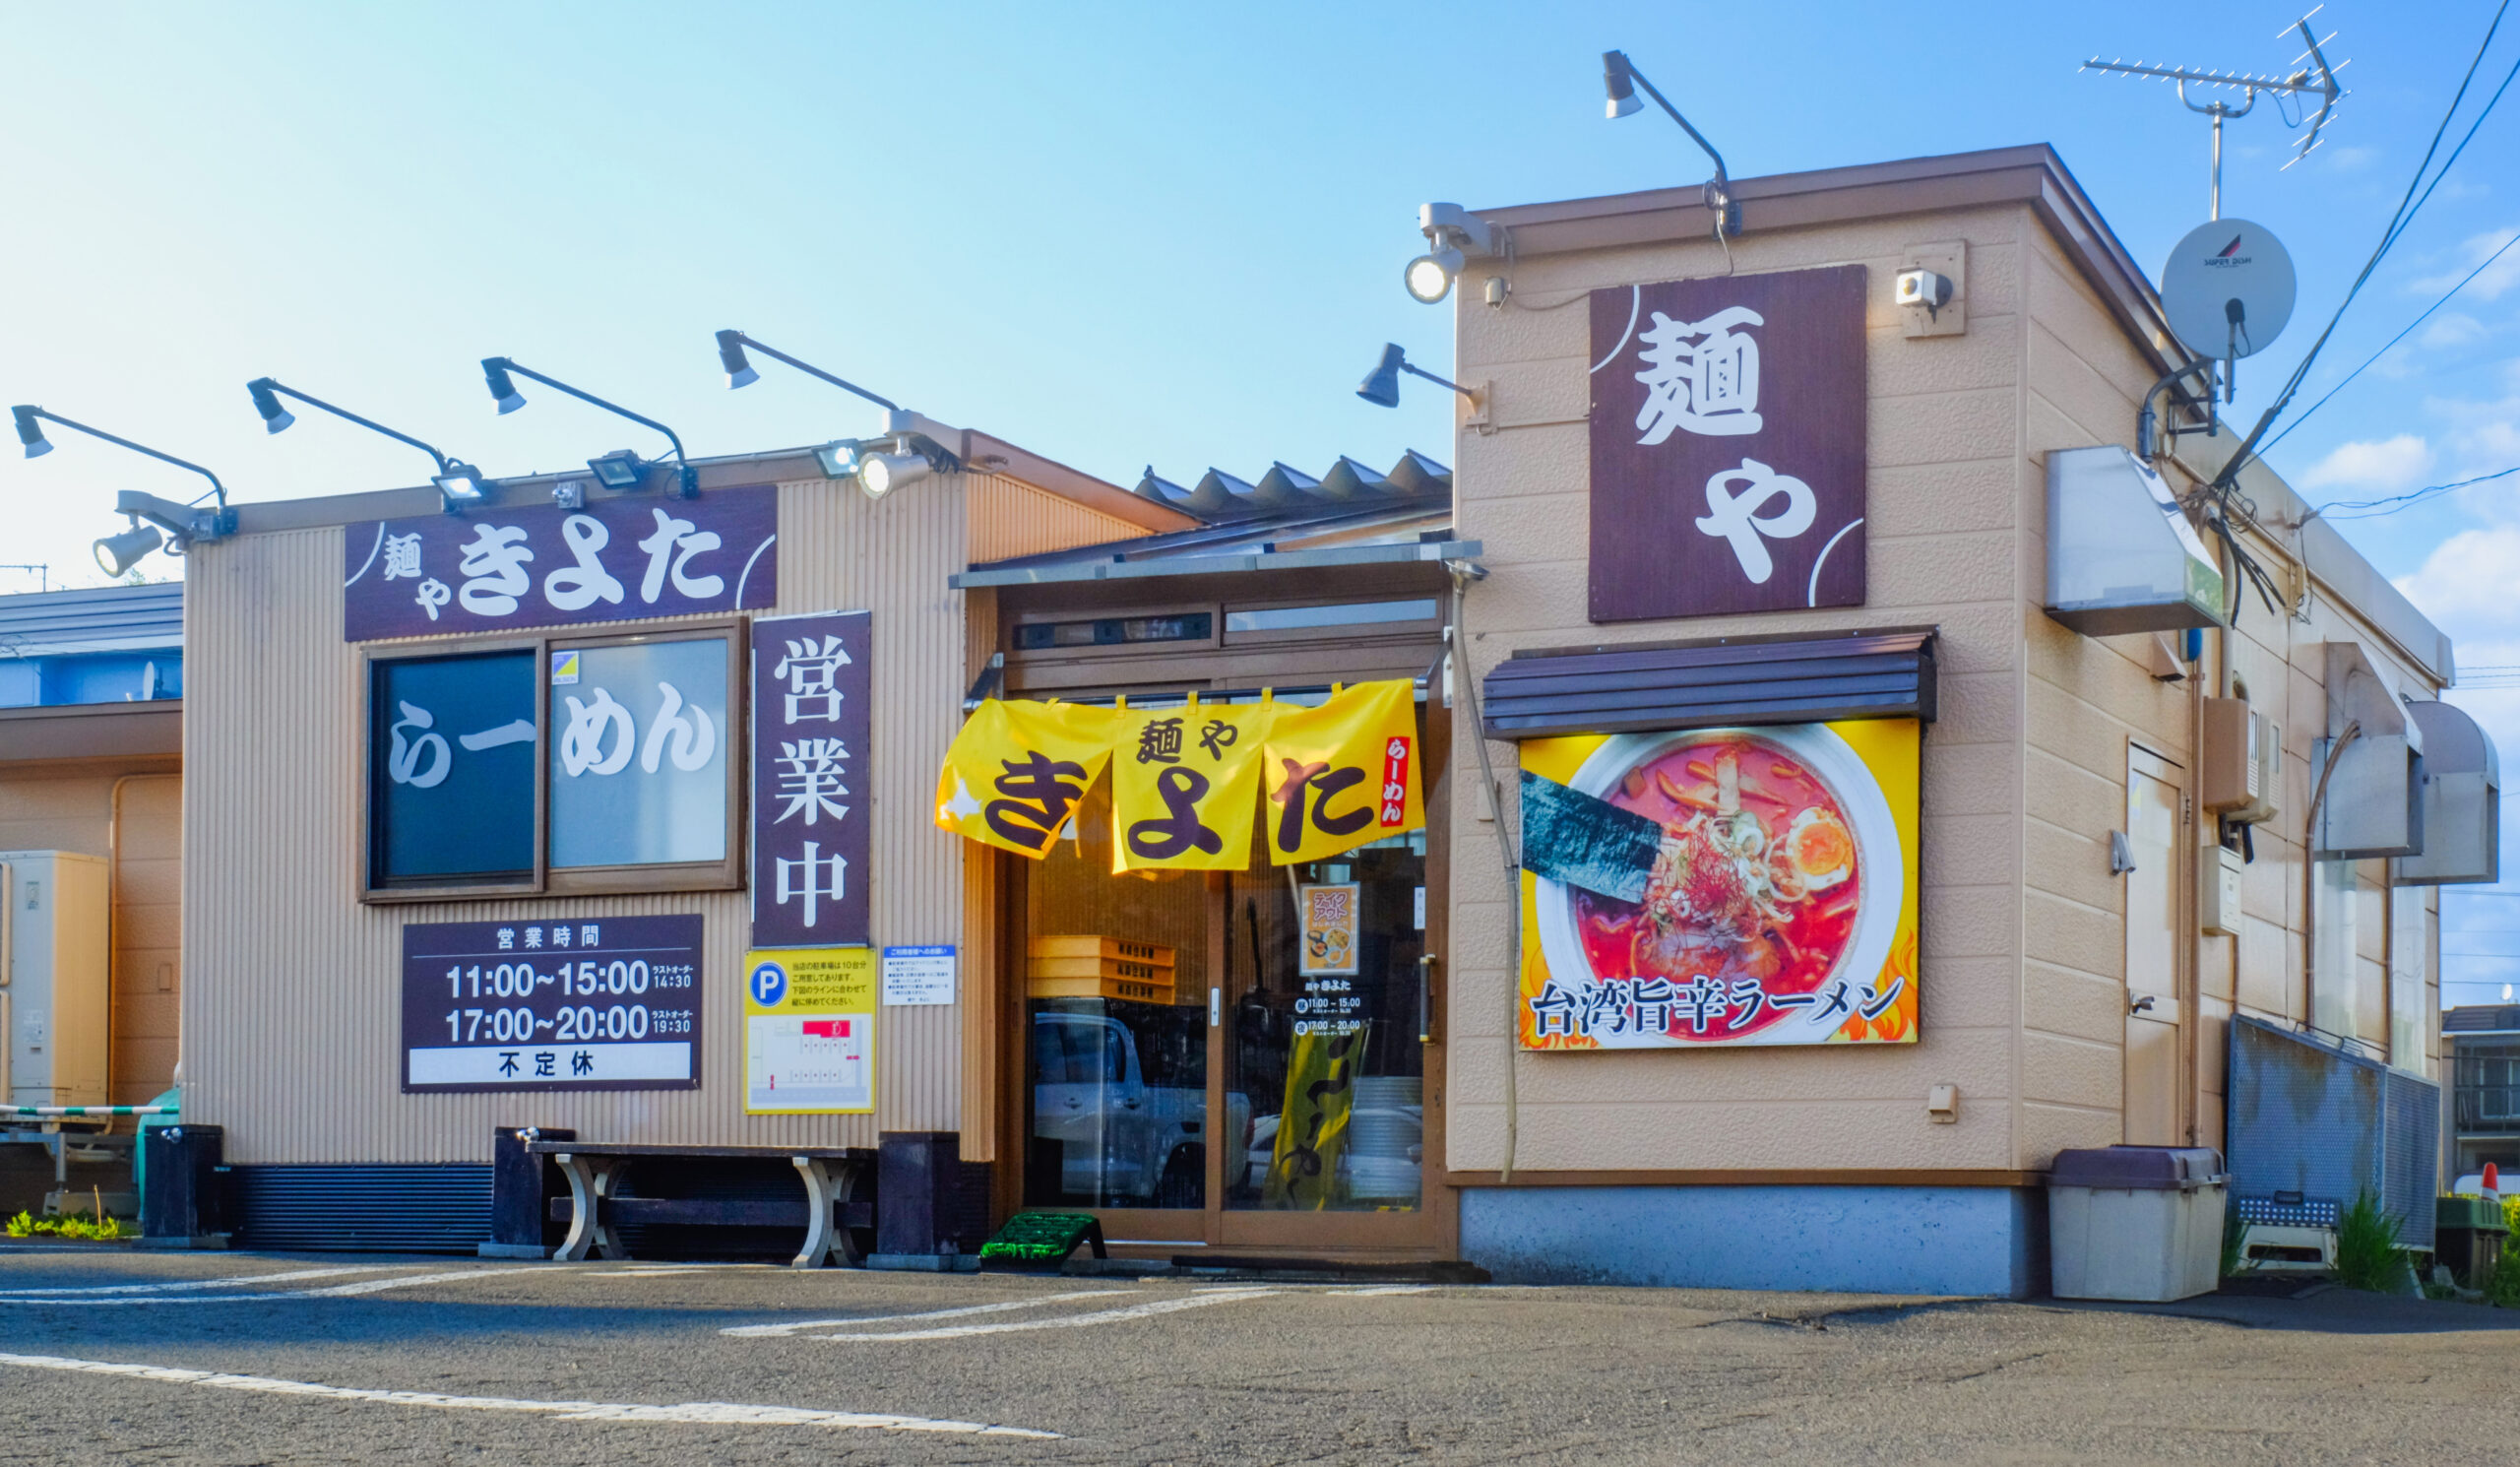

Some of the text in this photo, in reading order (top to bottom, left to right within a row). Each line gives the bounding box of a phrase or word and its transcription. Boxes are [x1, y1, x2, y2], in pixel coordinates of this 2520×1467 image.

[1634, 305, 1817, 584] 麺や
[459, 508, 724, 616] きよた
[389, 682, 716, 789] らーめん
[1136, 717, 1238, 765] 麺や
[774, 635, 852, 927] 営業中
[1381, 737, 1407, 823] らーめん
[984, 750, 1375, 860] きよた
[497, 925, 600, 949] 営業時間
[653, 965, 694, 975] ラストオーダー
[654, 975, 691, 989] 14:30
[760, 970, 780, 999] P
[652, 1009, 694, 1020] ラストオーダー
[1339, 997, 1360, 1007] 15:00
[1531, 976, 1906, 1038] 台湾旨辛ラーメン
[653, 1019, 691, 1034] 19:30
[1337, 1020, 1360, 1030] 20:00
[499, 1051, 594, 1077] 不定休
